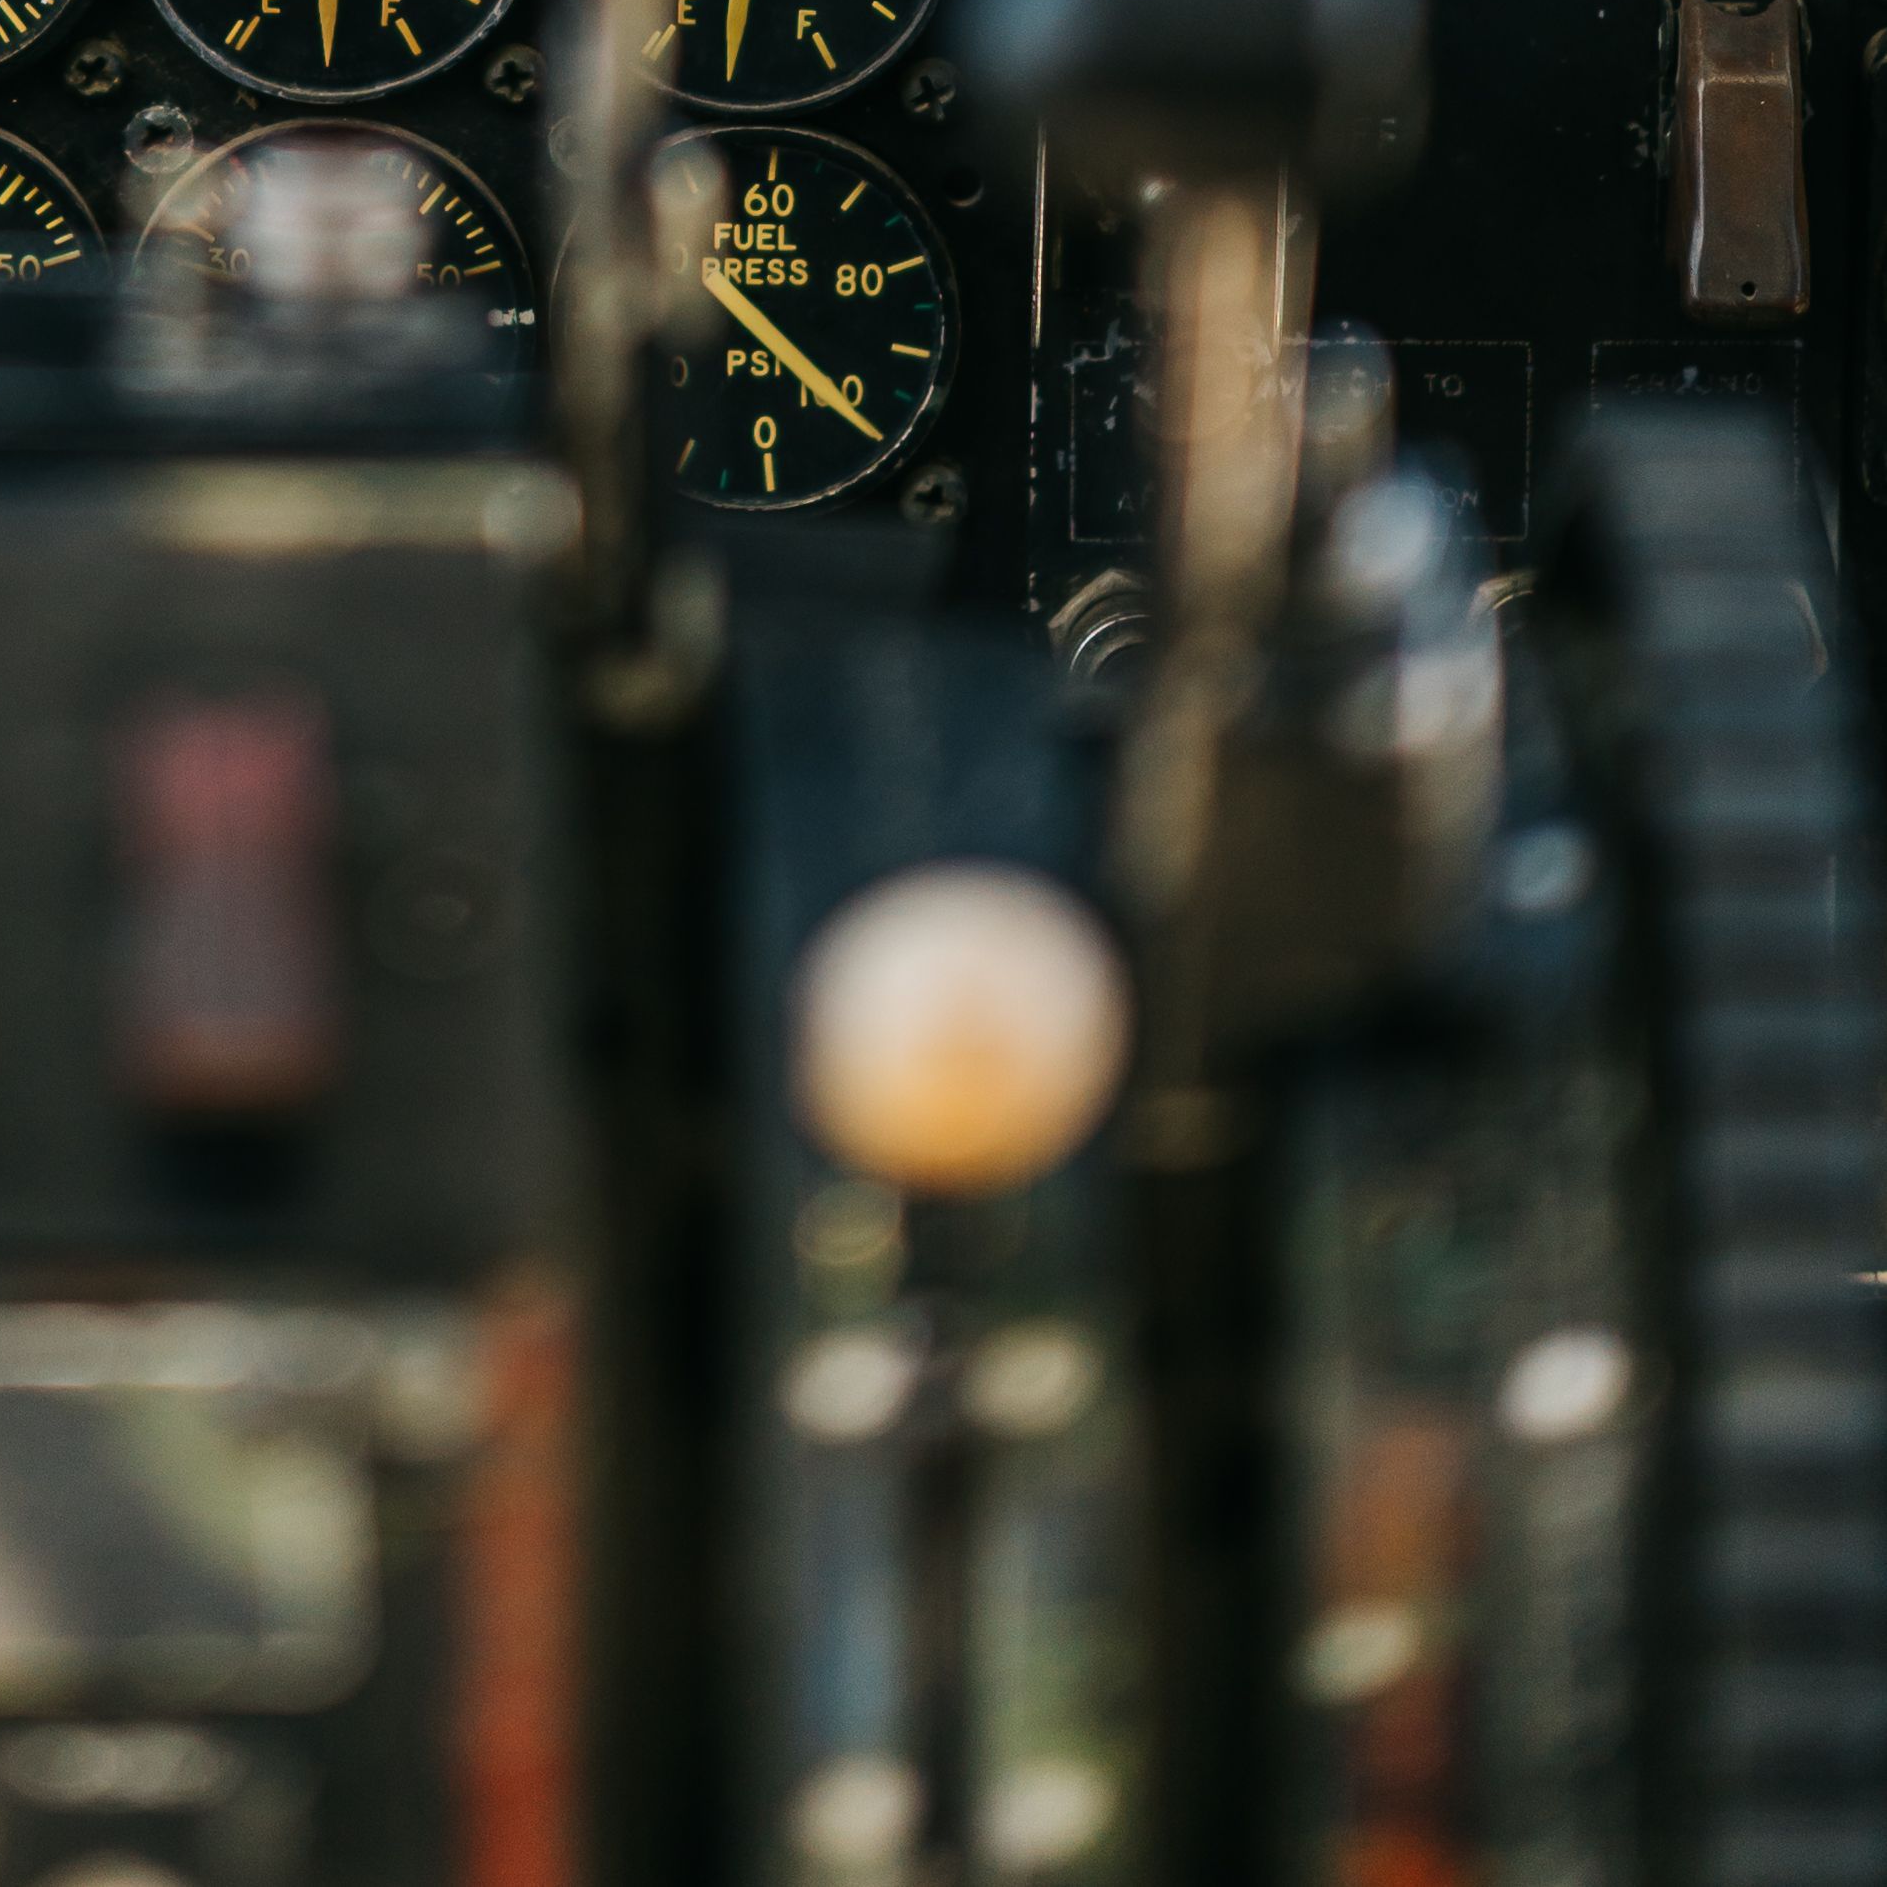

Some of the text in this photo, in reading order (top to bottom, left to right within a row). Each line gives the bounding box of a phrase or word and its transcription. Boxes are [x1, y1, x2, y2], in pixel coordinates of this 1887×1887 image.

[797, 10, 816, 40] F
[744, 183, 794, 217] 60
[714, 223, 796, 252] FUEL
[702, 258, 808, 286] PRESS
[754, 416, 777, 449] 0
